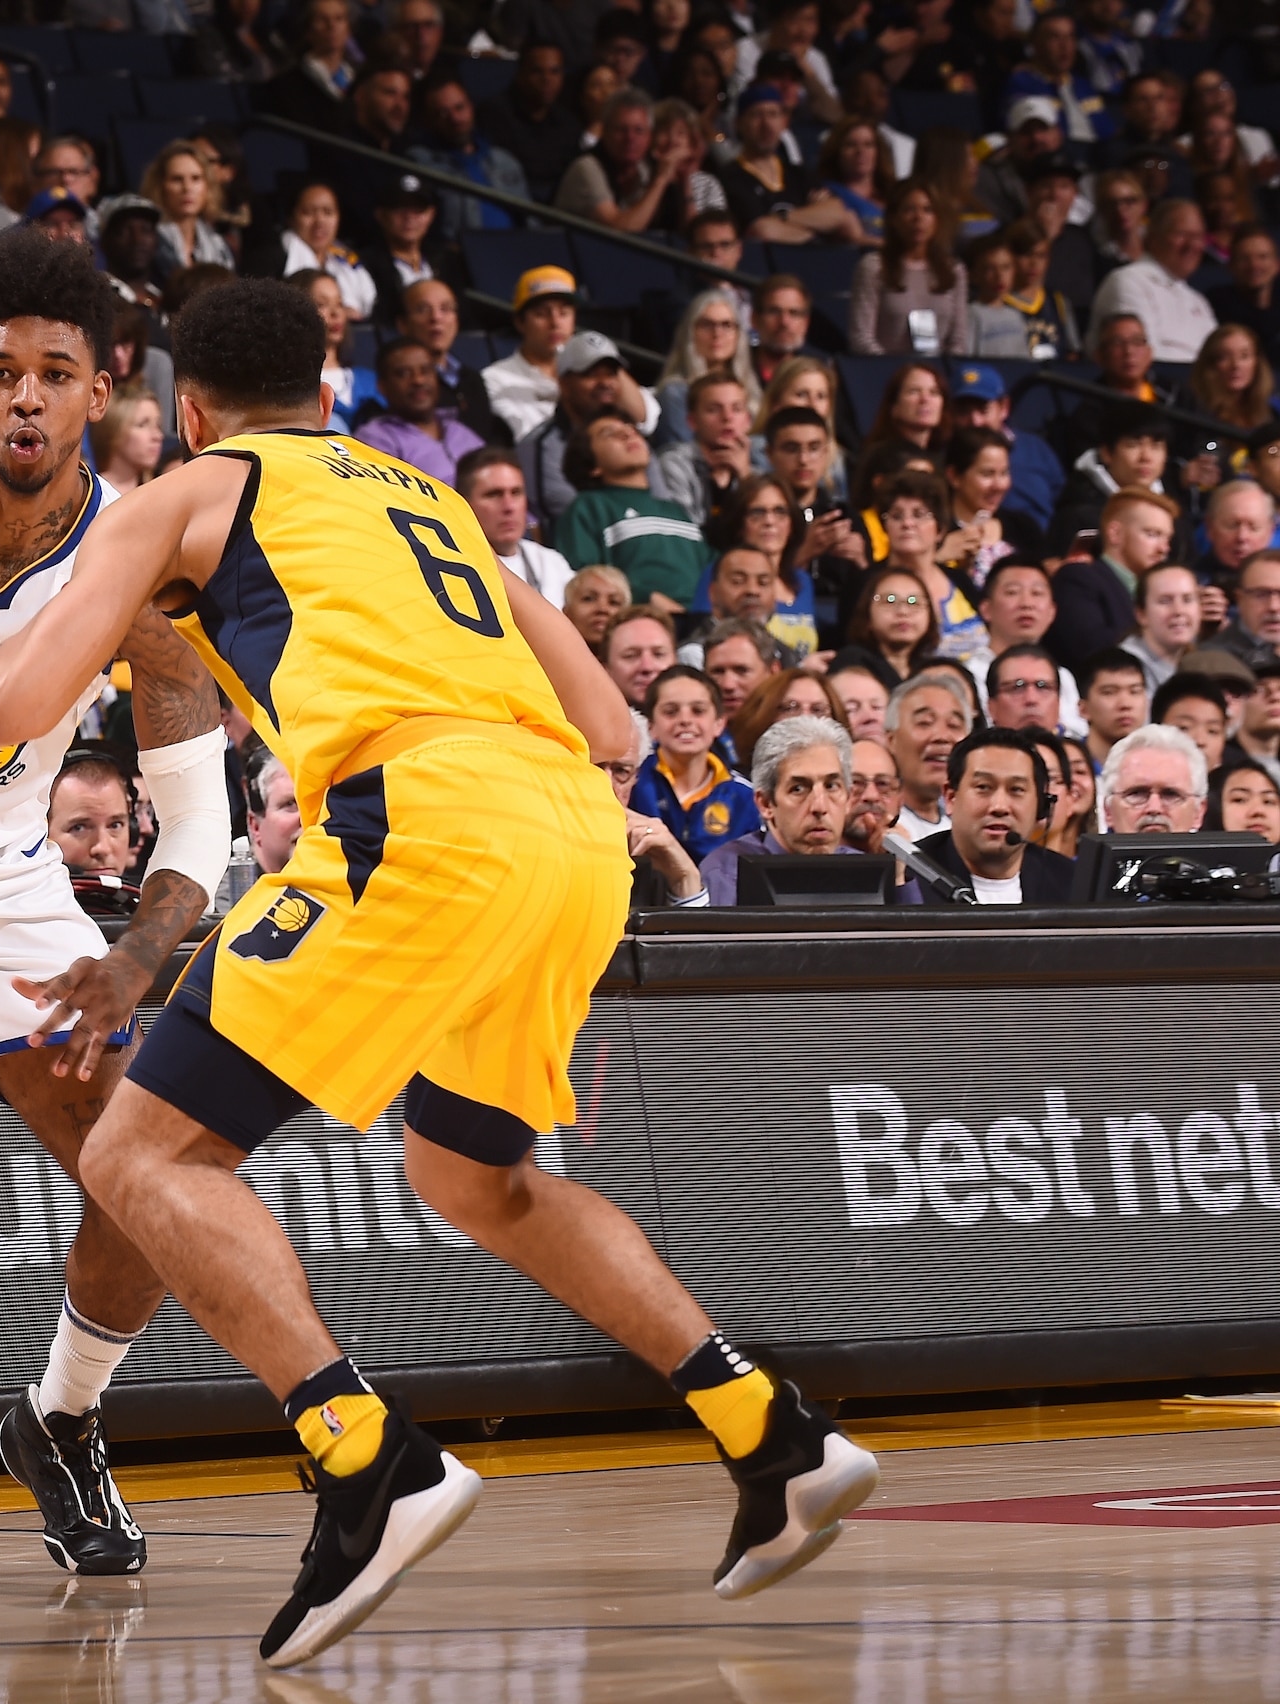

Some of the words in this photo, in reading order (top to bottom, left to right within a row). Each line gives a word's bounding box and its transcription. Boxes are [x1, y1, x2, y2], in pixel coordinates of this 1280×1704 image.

[306, 453, 440, 503] JOSEPH
[385, 506, 505, 639] 6
[829, 1083, 1096, 1227] Best
[1103, 1081, 1280, 1216] net
